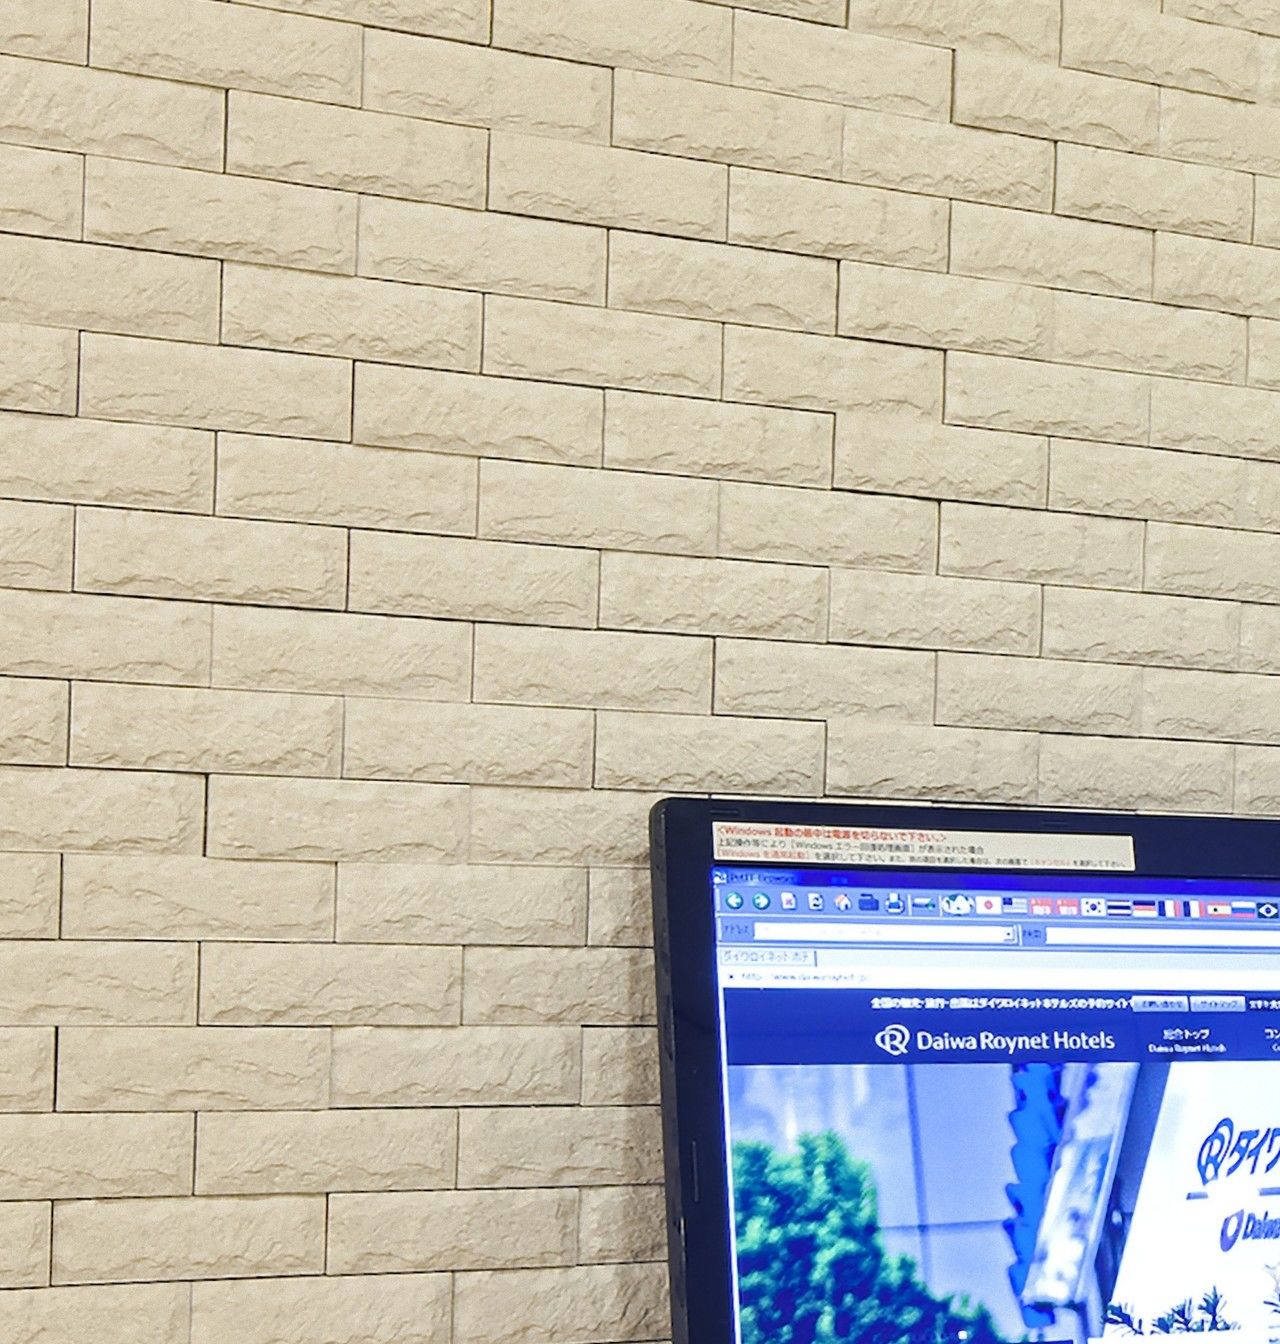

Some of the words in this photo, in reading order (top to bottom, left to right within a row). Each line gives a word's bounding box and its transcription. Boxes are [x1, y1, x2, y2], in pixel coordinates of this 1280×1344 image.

[916, 1031, 977, 1051] Daiwa
[979, 1031, 1050, 1055] Roynet
[1053, 1031, 1116, 1050] Hotels
